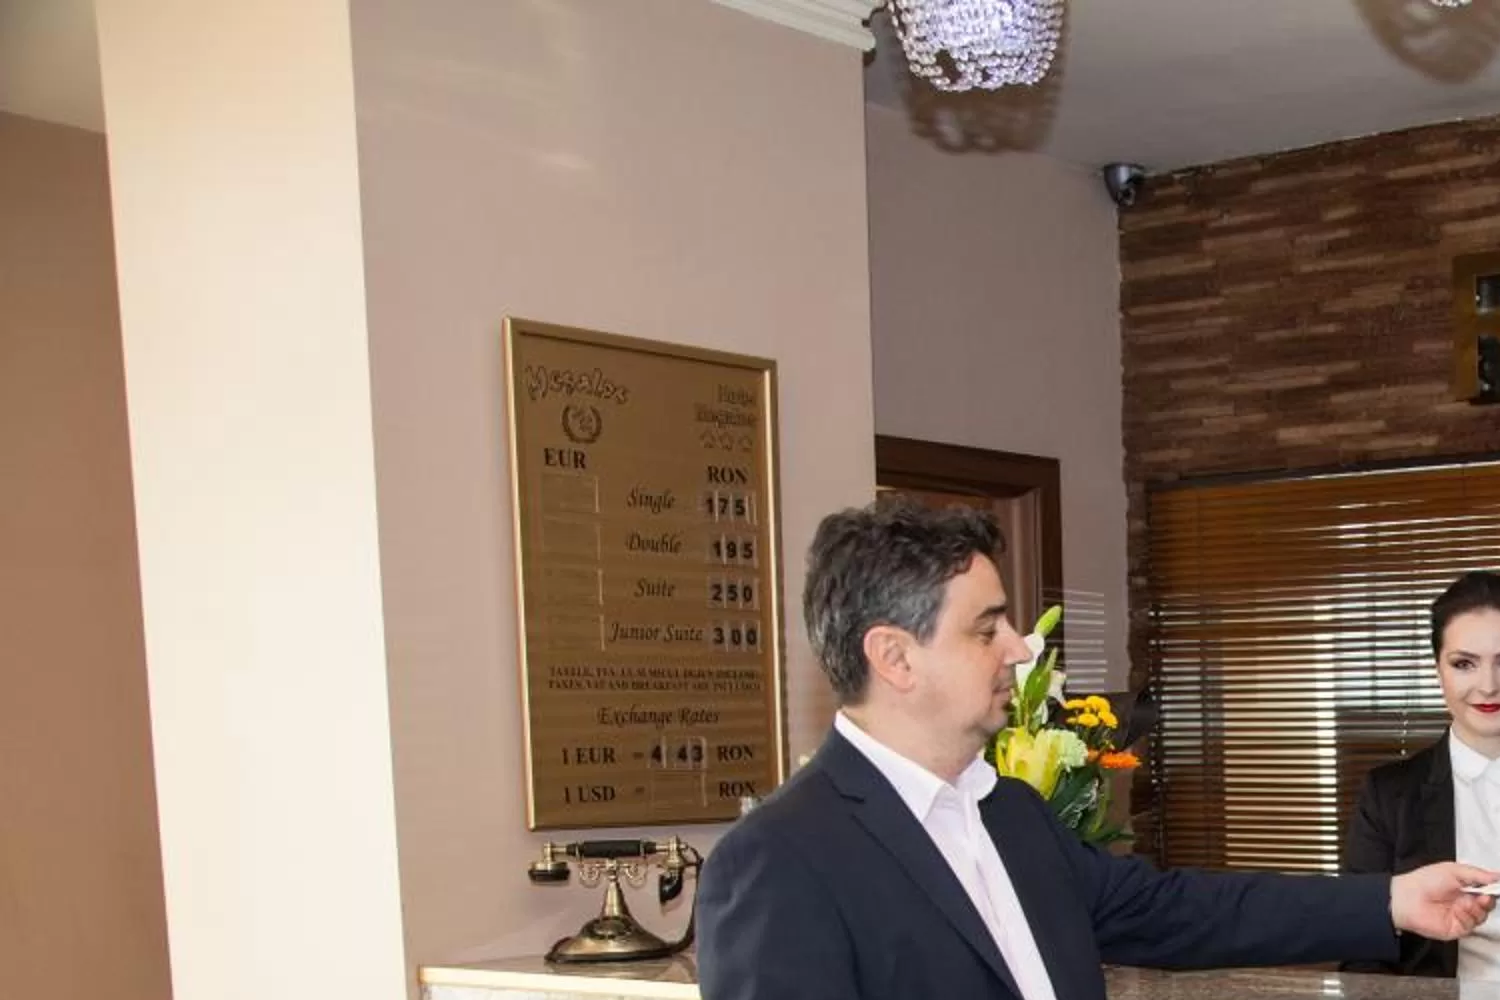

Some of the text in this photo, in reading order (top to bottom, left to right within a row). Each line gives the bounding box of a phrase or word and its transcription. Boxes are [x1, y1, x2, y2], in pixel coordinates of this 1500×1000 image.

[543, 447, 587, 469] EUR
[706, 464, 748, 485] RON
[626, 488, 747, 516] Single 175
[625, 532, 753, 559] Double 195
[633, 577, 753, 602] Suite 250
[609, 621, 758, 645] Junior Suite 300
[598, 704, 722, 729] Exchange Rates
[576, 748, 617, 765] EUR
[717, 745, 755, 761] RON
[578, 786, 616, 803] USD
[718, 781, 758, 798] RON
